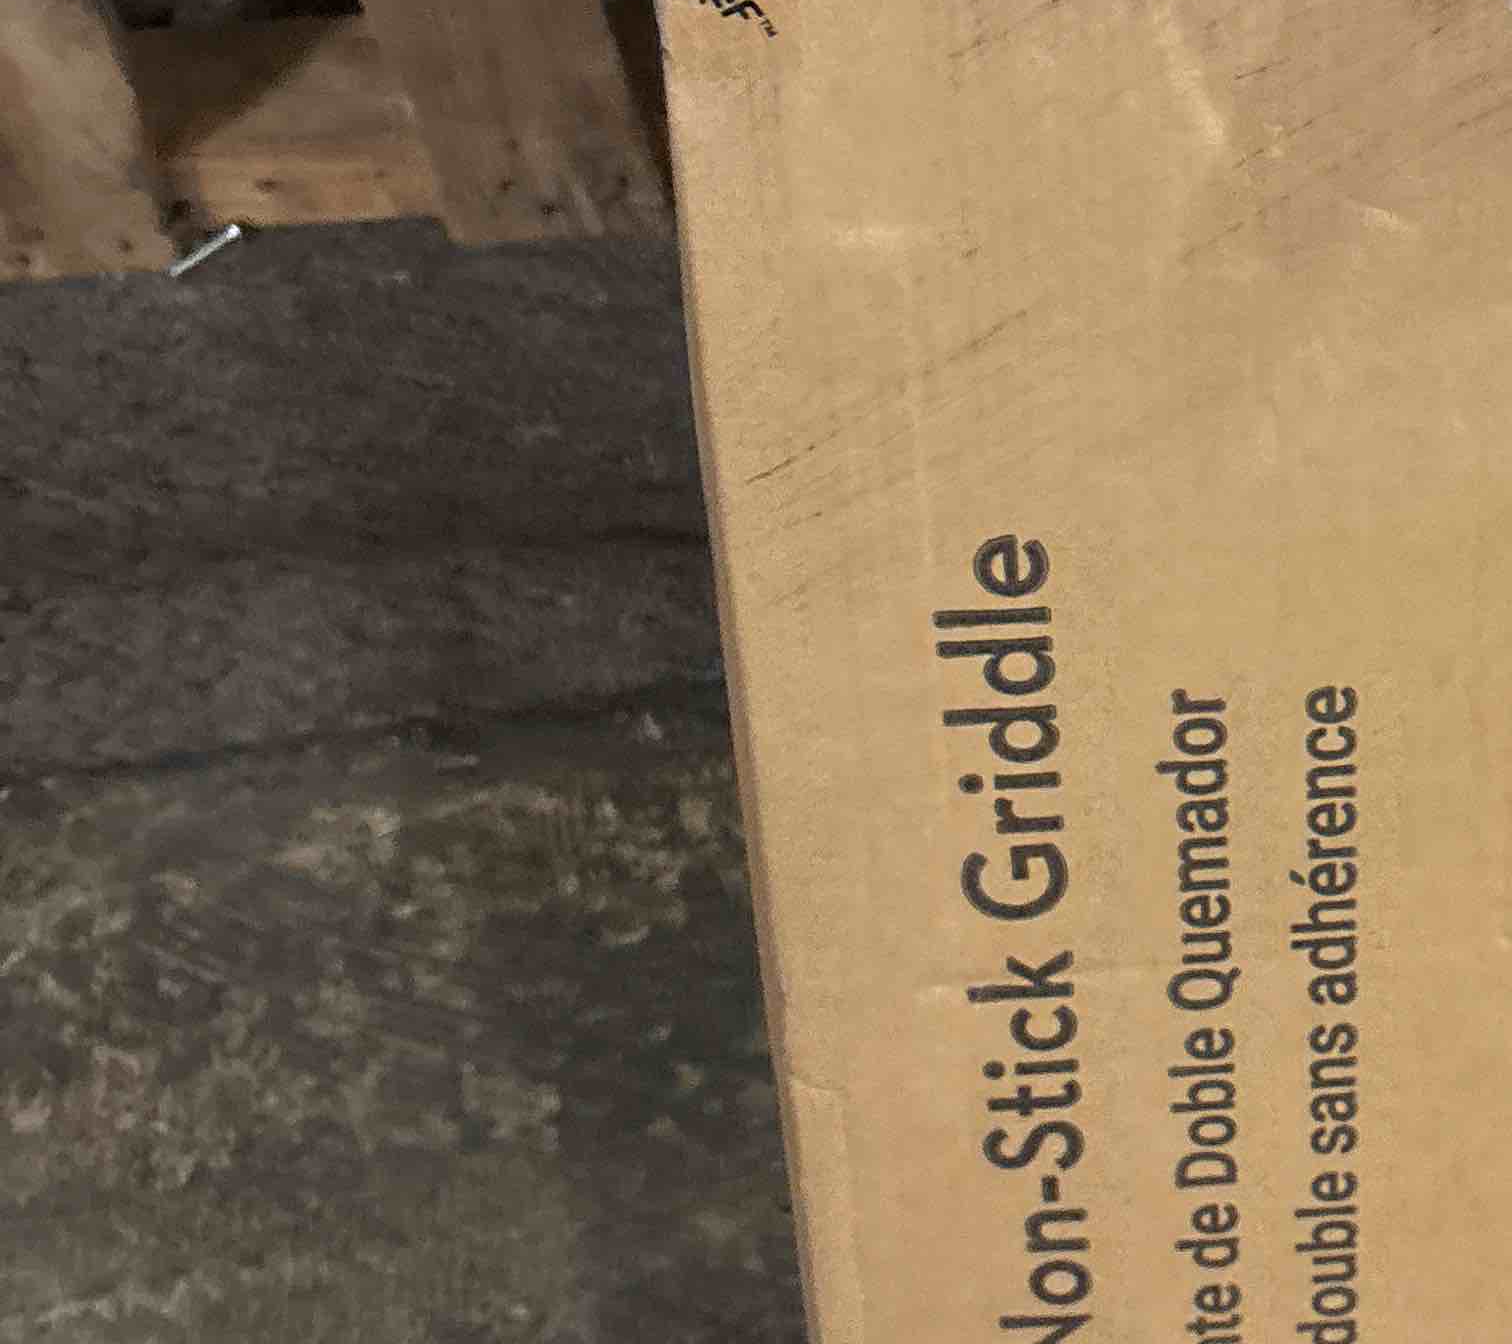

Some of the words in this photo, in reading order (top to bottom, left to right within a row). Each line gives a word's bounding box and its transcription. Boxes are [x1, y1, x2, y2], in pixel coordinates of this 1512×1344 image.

[932, 533, 1069, 922] Griddle
[1288, 685, 1359, 1006] adhérence
[1155, 688, 1242, 1012] Quemador
[1167, 1027, 1239, 1190] Doble
[1307, 1022, 1359, 1155] sans
[1174, 1203, 1240, 1270] de
